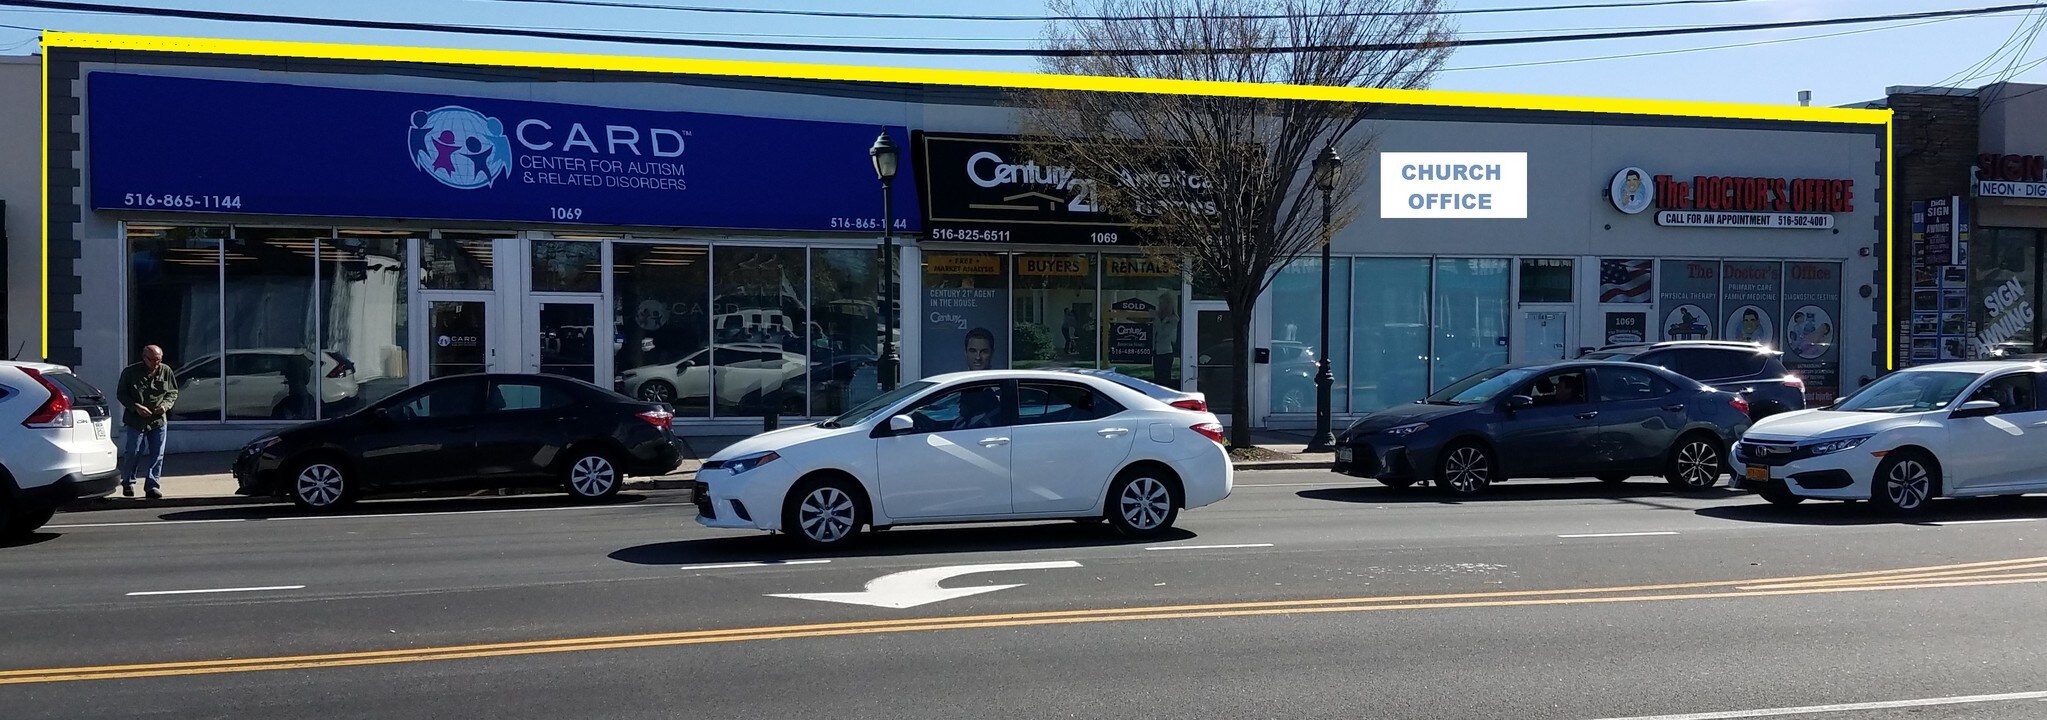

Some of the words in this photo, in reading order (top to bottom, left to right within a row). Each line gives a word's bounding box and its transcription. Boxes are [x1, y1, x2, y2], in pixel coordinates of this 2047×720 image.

[516, 118, 685, 158] CARD
[519, 154, 586, 171] CENTER
[590, 159, 622, 173] FOR
[628, 161, 685, 176] AUTISM
[1976, 153, 2044, 181] SIGN
[523, 171, 536, 184] &
[539, 172, 603, 187] RELATED
[606, 175, 687, 191] DISORDERS
[1654, 174, 1690, 209] The
[1694, 175, 1786, 211] DOCTOR'S
[1790, 178, 1854, 212] OFFICE
[1982, 182, 2015, 195] NEON
[124, 193, 242, 209] 516-865-1144
[550, 207, 582, 220] 1069
[1927, 206, 1949, 217] SIGN
[830, 217, 907, 229] 516-865-144
[1665, 213, 1686, 224] CALL
[1686, 213, 1701, 225] FOR
[1703, 214, 1715, 225] AN
[1716, 214, 1771, 226] APPOINTMENT
[1778, 214, 1828, 227] 516-502-4001
[932, 228, 1010, 242] 516-825-6511
[1090, 232, 1118, 244] 1069
[1027, 260, 1080, 273] BUYERS
[1111, 261, 1170, 273] RENTALS
[1687, 263, 1713, 279] The
[1791, 264, 1831, 279] Office
[930, 289, 961, 298] CENTURY
[973, 289, 996, 298] AGENT
[1728, 283, 1755, 291] PRIMARY
[930, 298, 939, 307] IN
[940, 298, 952, 307] THE
[1660, 292, 1689, 300] PHYSICAL
[1690, 292, 1716, 300] THERAPY
[1747, 293, 1777, 301] MEDICINE
[1984, 276, 2025, 318] SIGN
[1122, 302, 1146, 310] SOLD
[1615, 317, 1635, 326] 1069
[1974, 300, 2035, 360] AWNING
